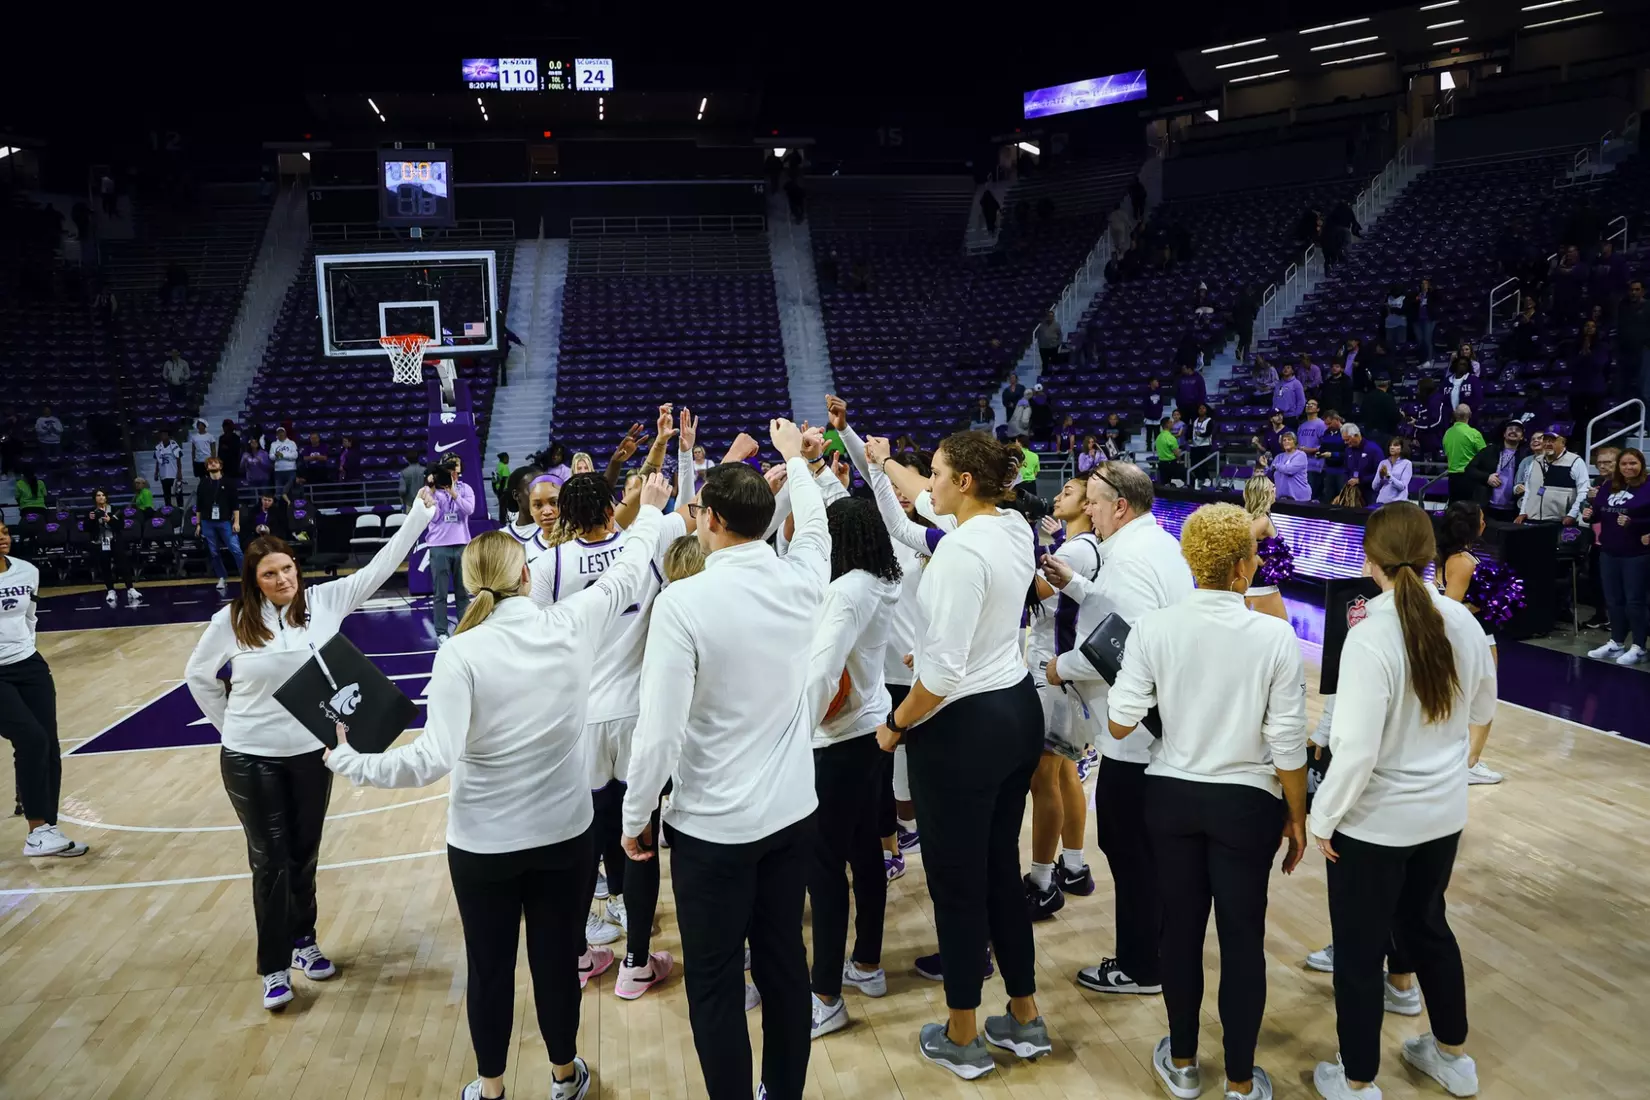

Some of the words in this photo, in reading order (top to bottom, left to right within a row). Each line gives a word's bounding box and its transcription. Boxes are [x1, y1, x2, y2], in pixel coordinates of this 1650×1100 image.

[549, 60, 562, 70] 0.0
[502, 69, 535, 84] 110
[583, 69, 605, 84] 24
[149, 130, 182, 151] 12
[876, 126, 904, 147] 15
[309, 191, 323, 201] 13
[751, 184, 765, 194] 14
[579, 546, 625, 574] LEST
